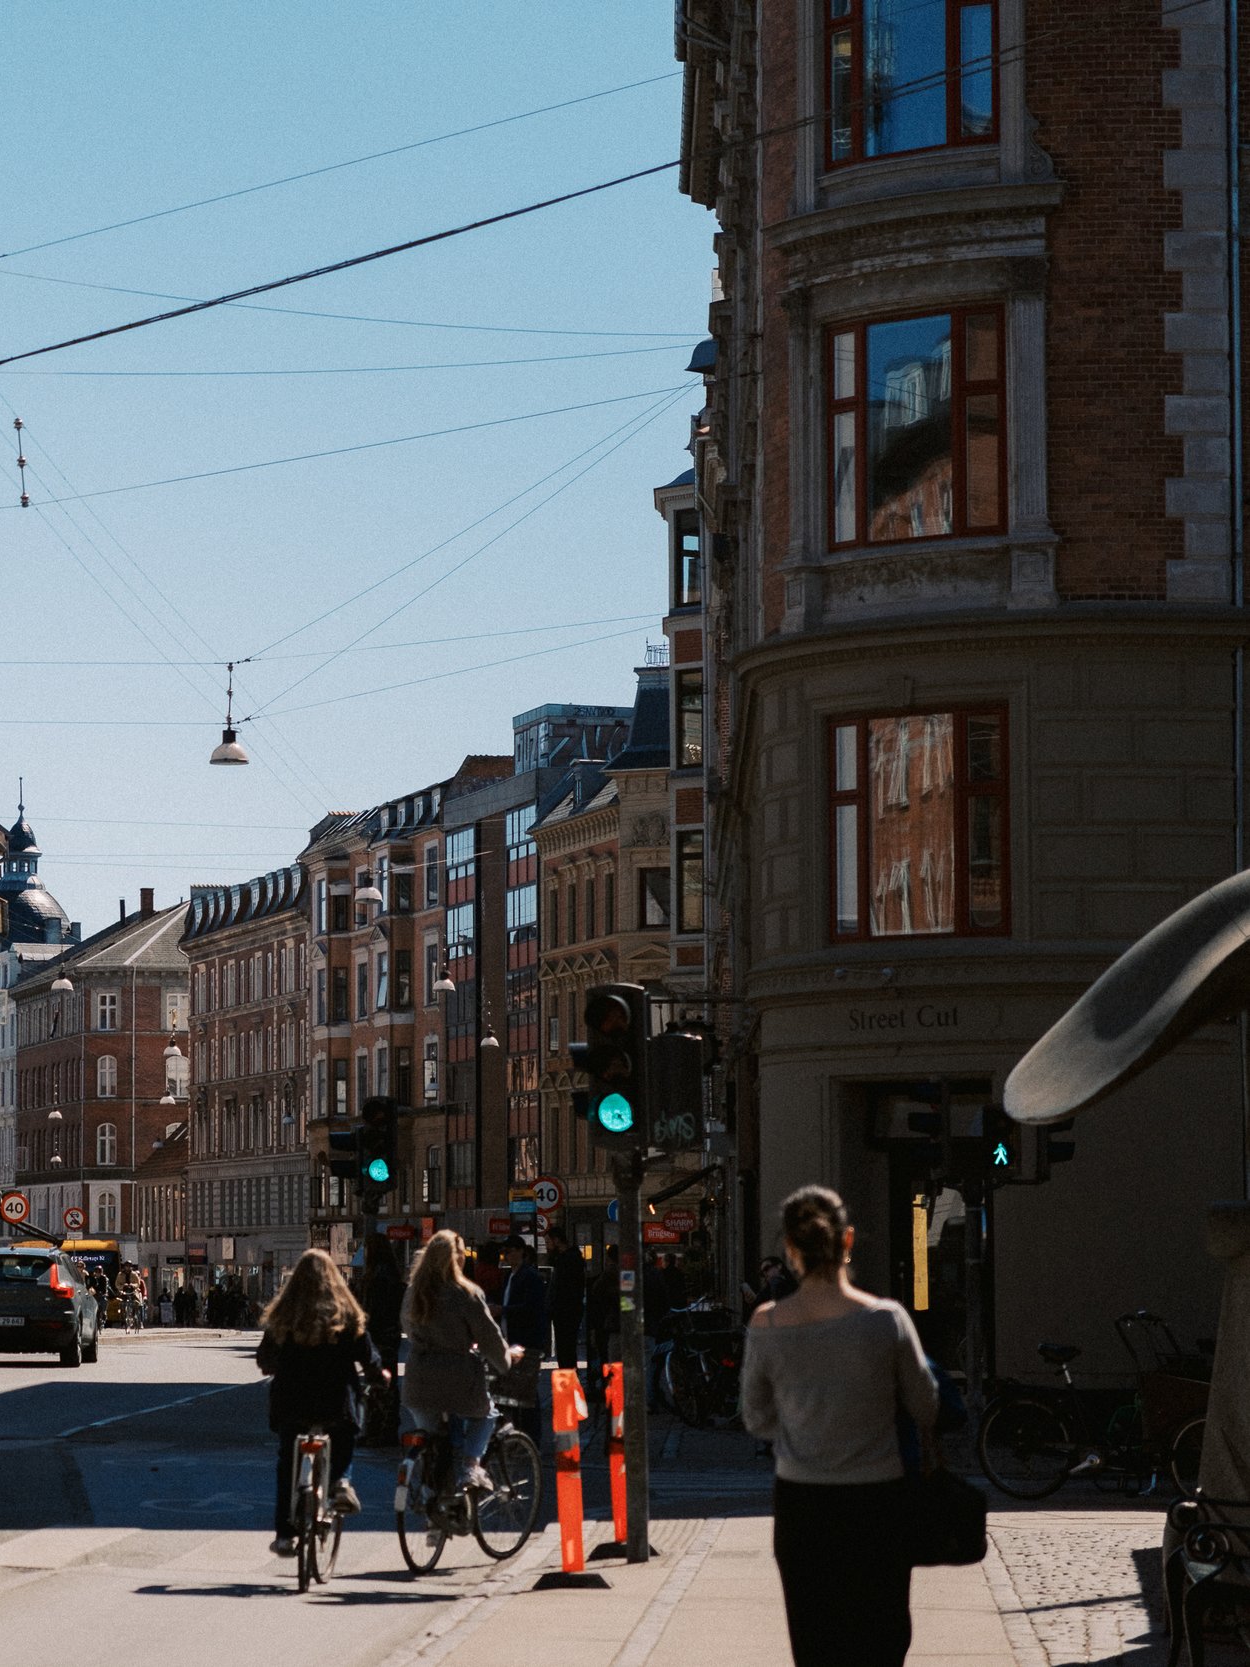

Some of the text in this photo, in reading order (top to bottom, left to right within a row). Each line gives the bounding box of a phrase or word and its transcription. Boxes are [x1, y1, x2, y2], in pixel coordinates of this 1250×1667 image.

[849, 1004, 959, 1031] Street Cut
[537, 1188, 557, 1202] 40
[5, 1202, 24, 1214] 40
[665, 1219, 694, 1228] SHARM
